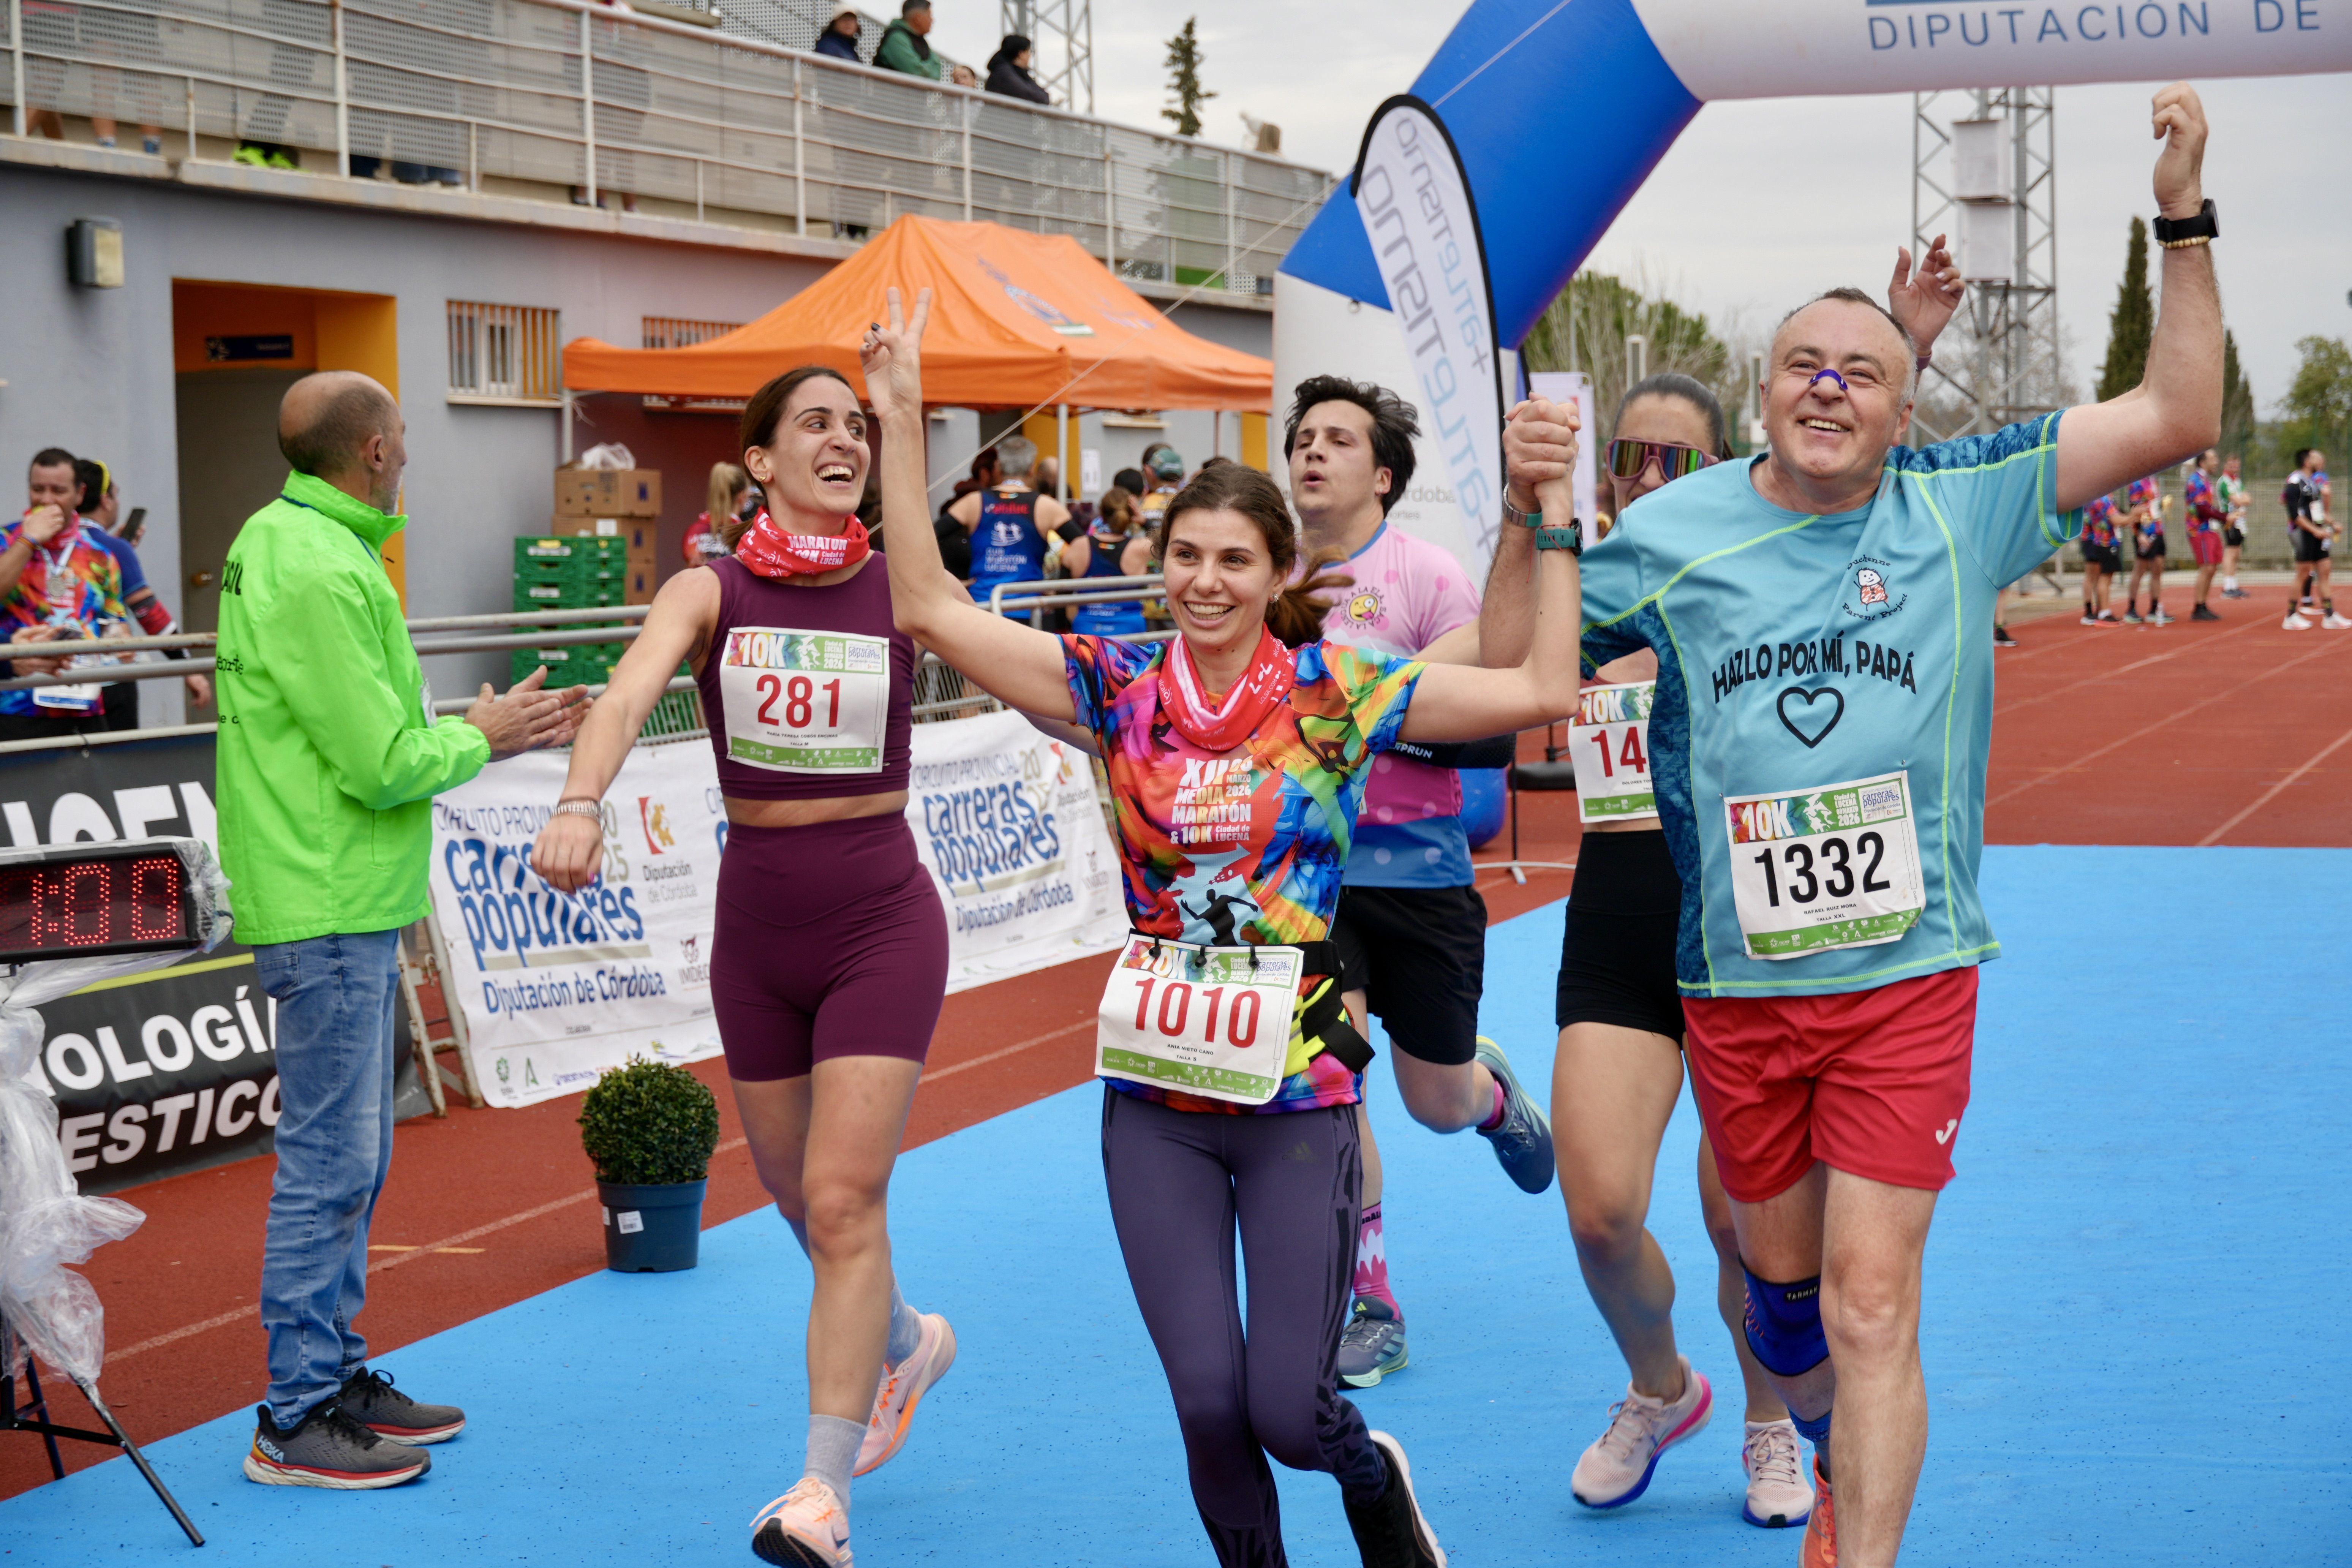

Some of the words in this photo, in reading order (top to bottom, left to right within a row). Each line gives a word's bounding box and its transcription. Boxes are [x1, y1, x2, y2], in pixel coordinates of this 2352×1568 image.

[2252, 0, 2321, 33] DE
[1842, 602, 1875, 621] Parent
[1879, 593, 1908, 618] Project
[739, 634, 787, 667] 10K
[824, 659, 844, 669] 2026
[849, 651, 880, 659] populares
[1712, 644, 1772, 705] HAZLO
[1777, 641, 1818, 677] POR
[1821, 629, 1851, 678] MÍ,
[1856, 641, 1916, 695] PAPÁ
[757, 674, 840, 728] 281
[1581, 690, 1626, 724] 10K
[1179, 757, 1229, 789] XII
[1226, 773, 1251, 784] MARZO
[1174, 786, 1225, 805] MEDIA
[1225, 785, 1252, 797] 2026
[1834, 798, 1857, 808] LUCENA
[1862, 789, 1893, 801] carreras
[1863, 793, 1899, 808] populares
[923, 781, 1036, 839] carreras
[1171, 800, 1251, 824] MARATÓN
[1741, 800, 1795, 841] 10K
[1837, 812, 1860, 827] 2026
[1170, 831, 1179, 844] &
[1181, 825, 1212, 844] 10K
[1216, 824, 1240, 833] Ciudad
[1241, 824, 1250, 833] de
[1216, 832, 1250, 842] LUCENA
[931, 814, 1059, 898] populares
[1754, 831, 1891, 907] 1332
[457, 886, 643, 972] populares
[482, 971, 572, 1020] Diputación
[575, 971, 595, 1004] de
[597, 964, 667, 1001] Córdoba
[1135, 977, 1261, 1048] 1010
[22, 985, 276, 1098] OLOGÍ
[256, 1435, 284, 1464] HOKA
